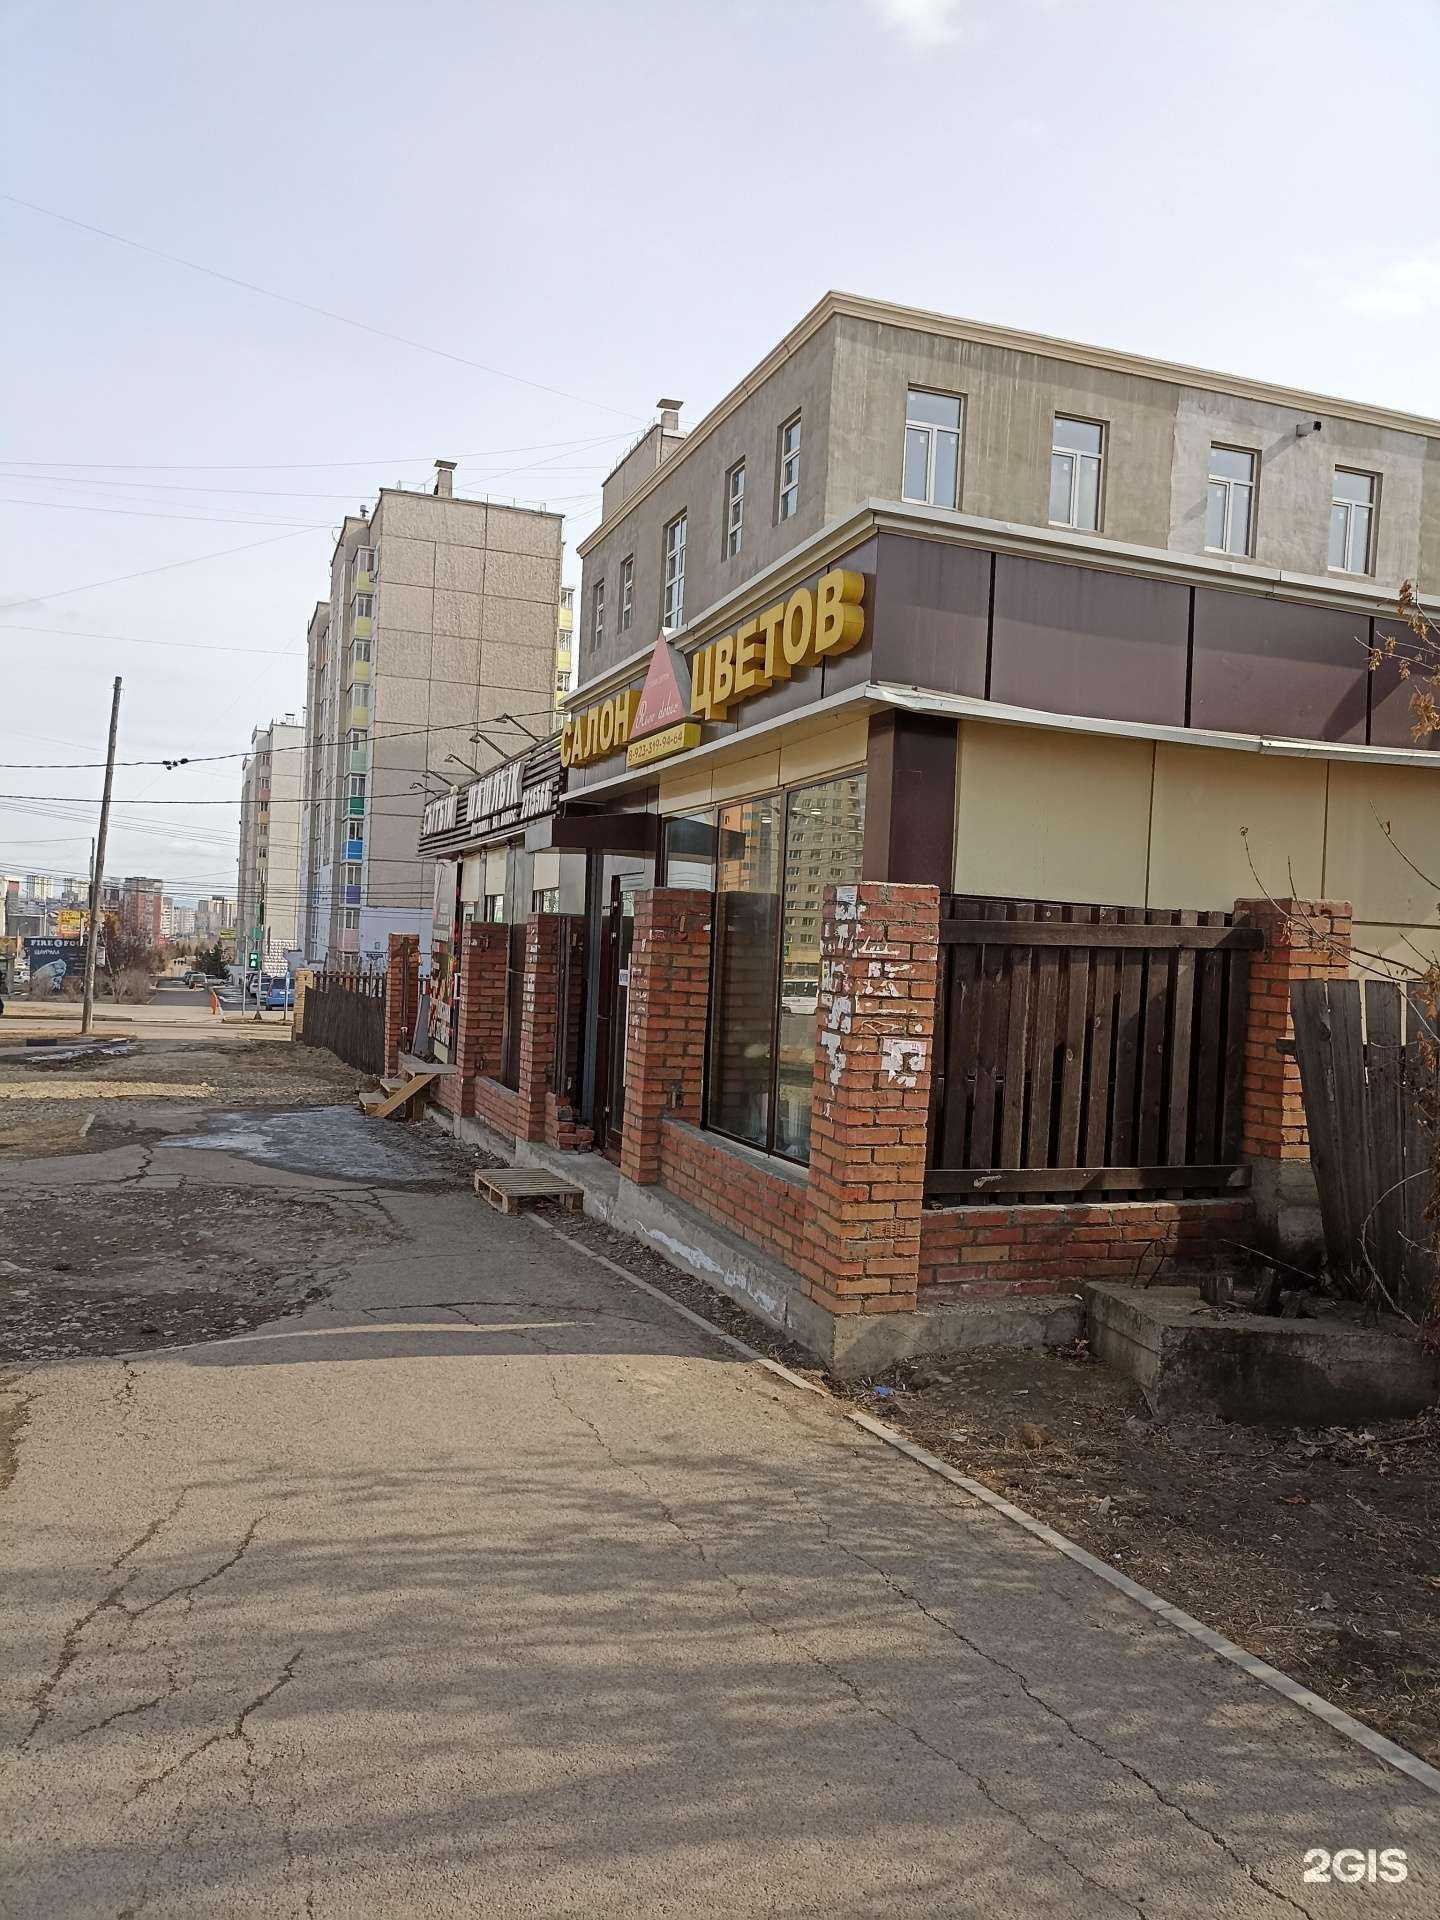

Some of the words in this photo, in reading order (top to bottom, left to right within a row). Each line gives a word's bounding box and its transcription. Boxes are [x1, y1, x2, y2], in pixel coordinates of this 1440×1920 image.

[560, 689, 643, 769] САЛОН
[690, 568, 865, 721] ЦВЕТОВ
[466, 761, 524, 821] ШАШЛЫК
